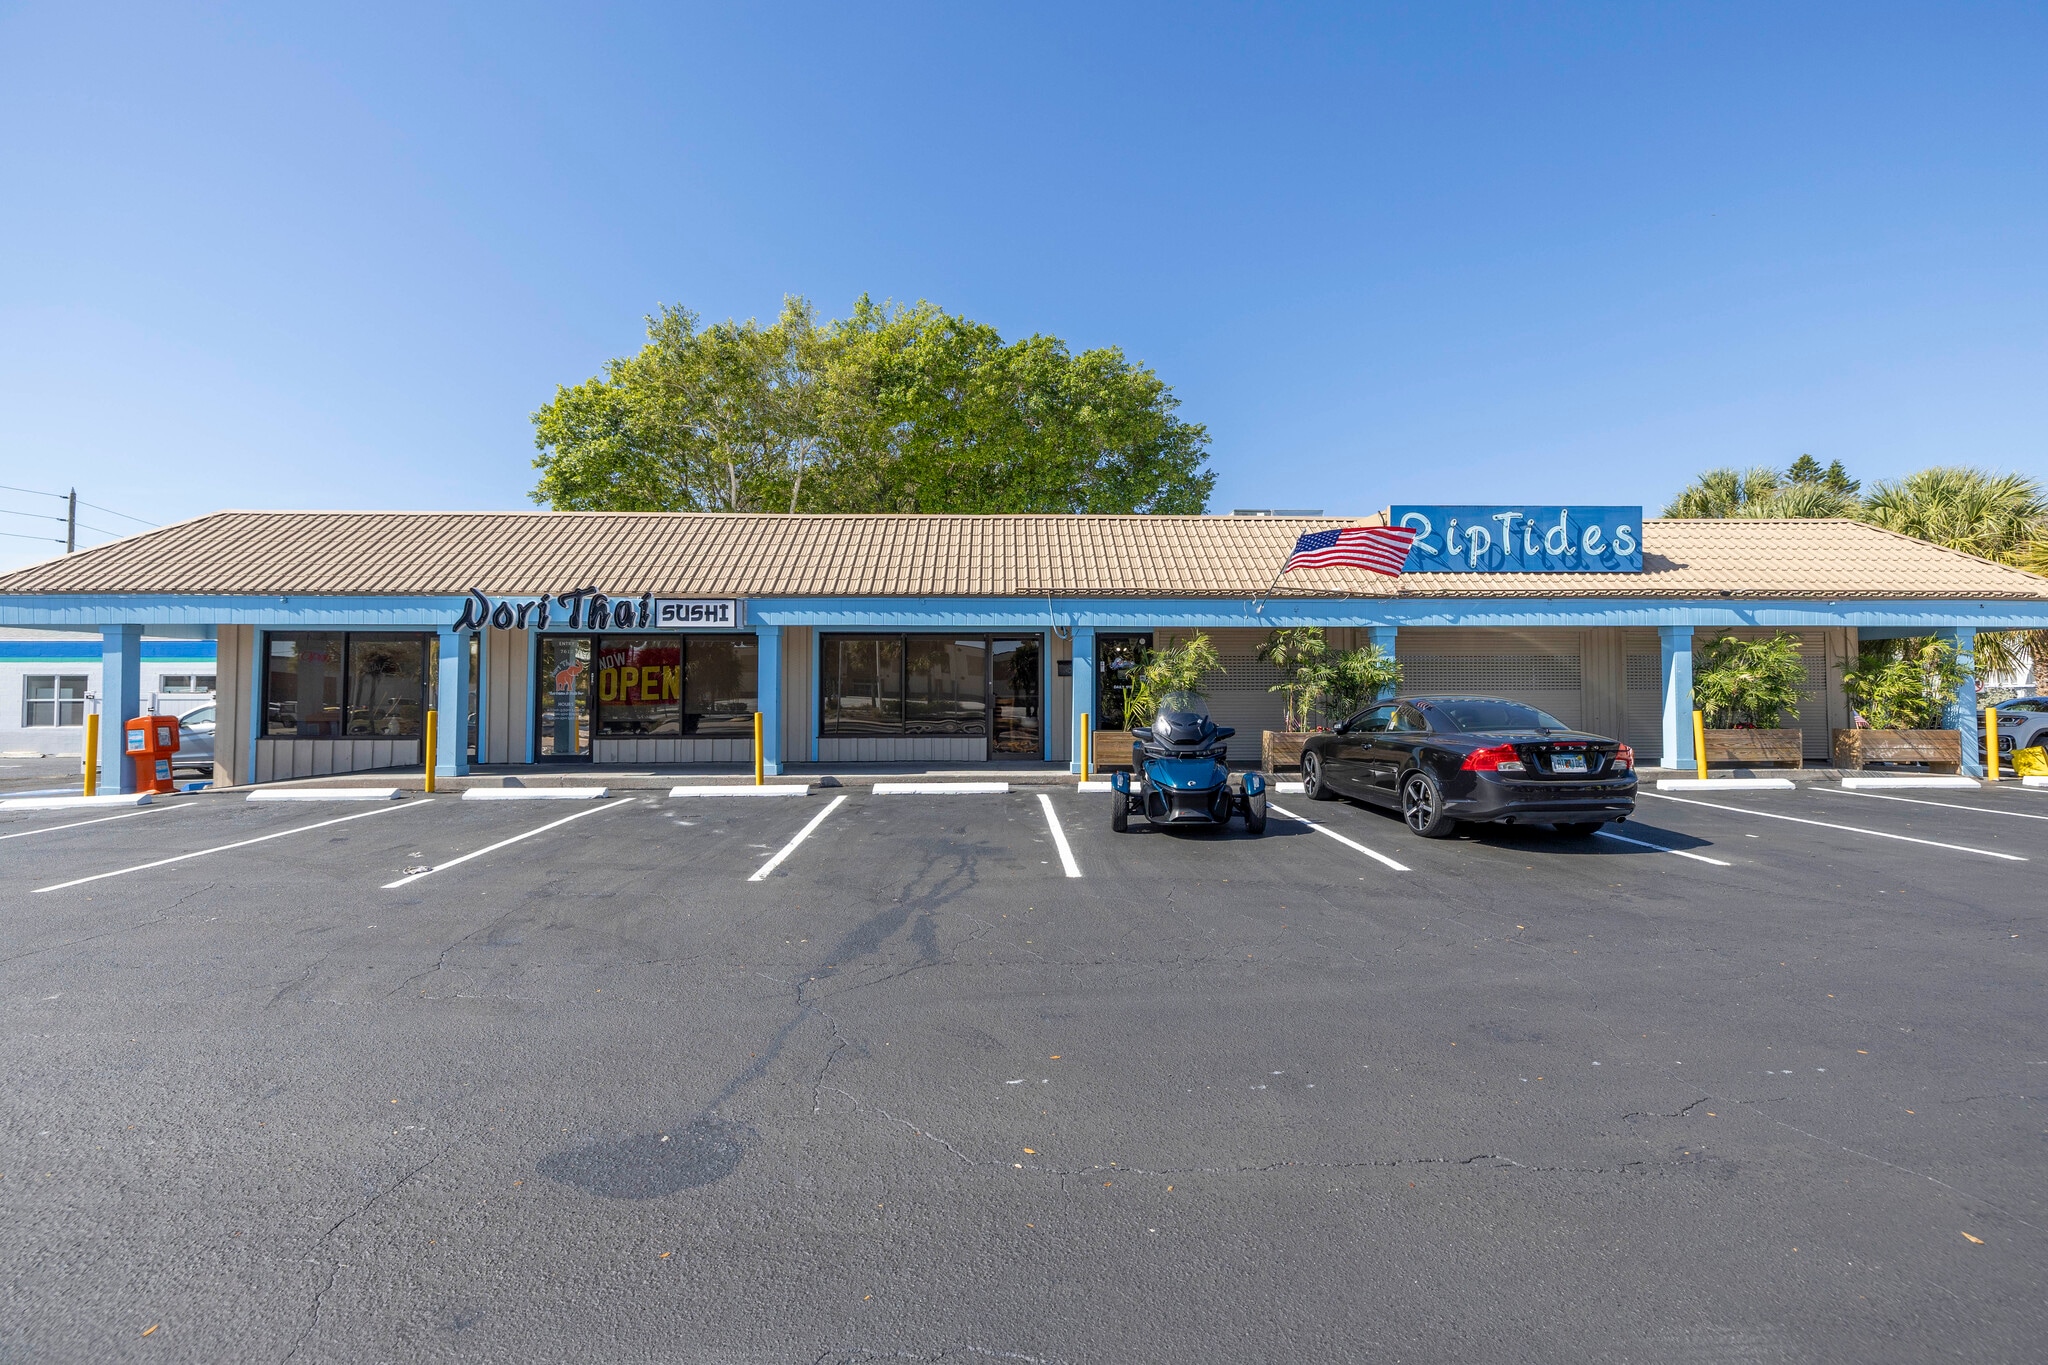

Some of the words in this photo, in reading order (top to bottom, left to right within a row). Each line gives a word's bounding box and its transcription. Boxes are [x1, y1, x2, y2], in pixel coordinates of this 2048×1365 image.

[1400, 509, 1635, 569] RipTides
[453, 587, 552, 632] Nori
[557, 585, 654, 630] Thai
[661, 603, 730, 622] SUSHI
[599, 652, 626, 671] NOW
[599, 665, 680, 702] OPEN
